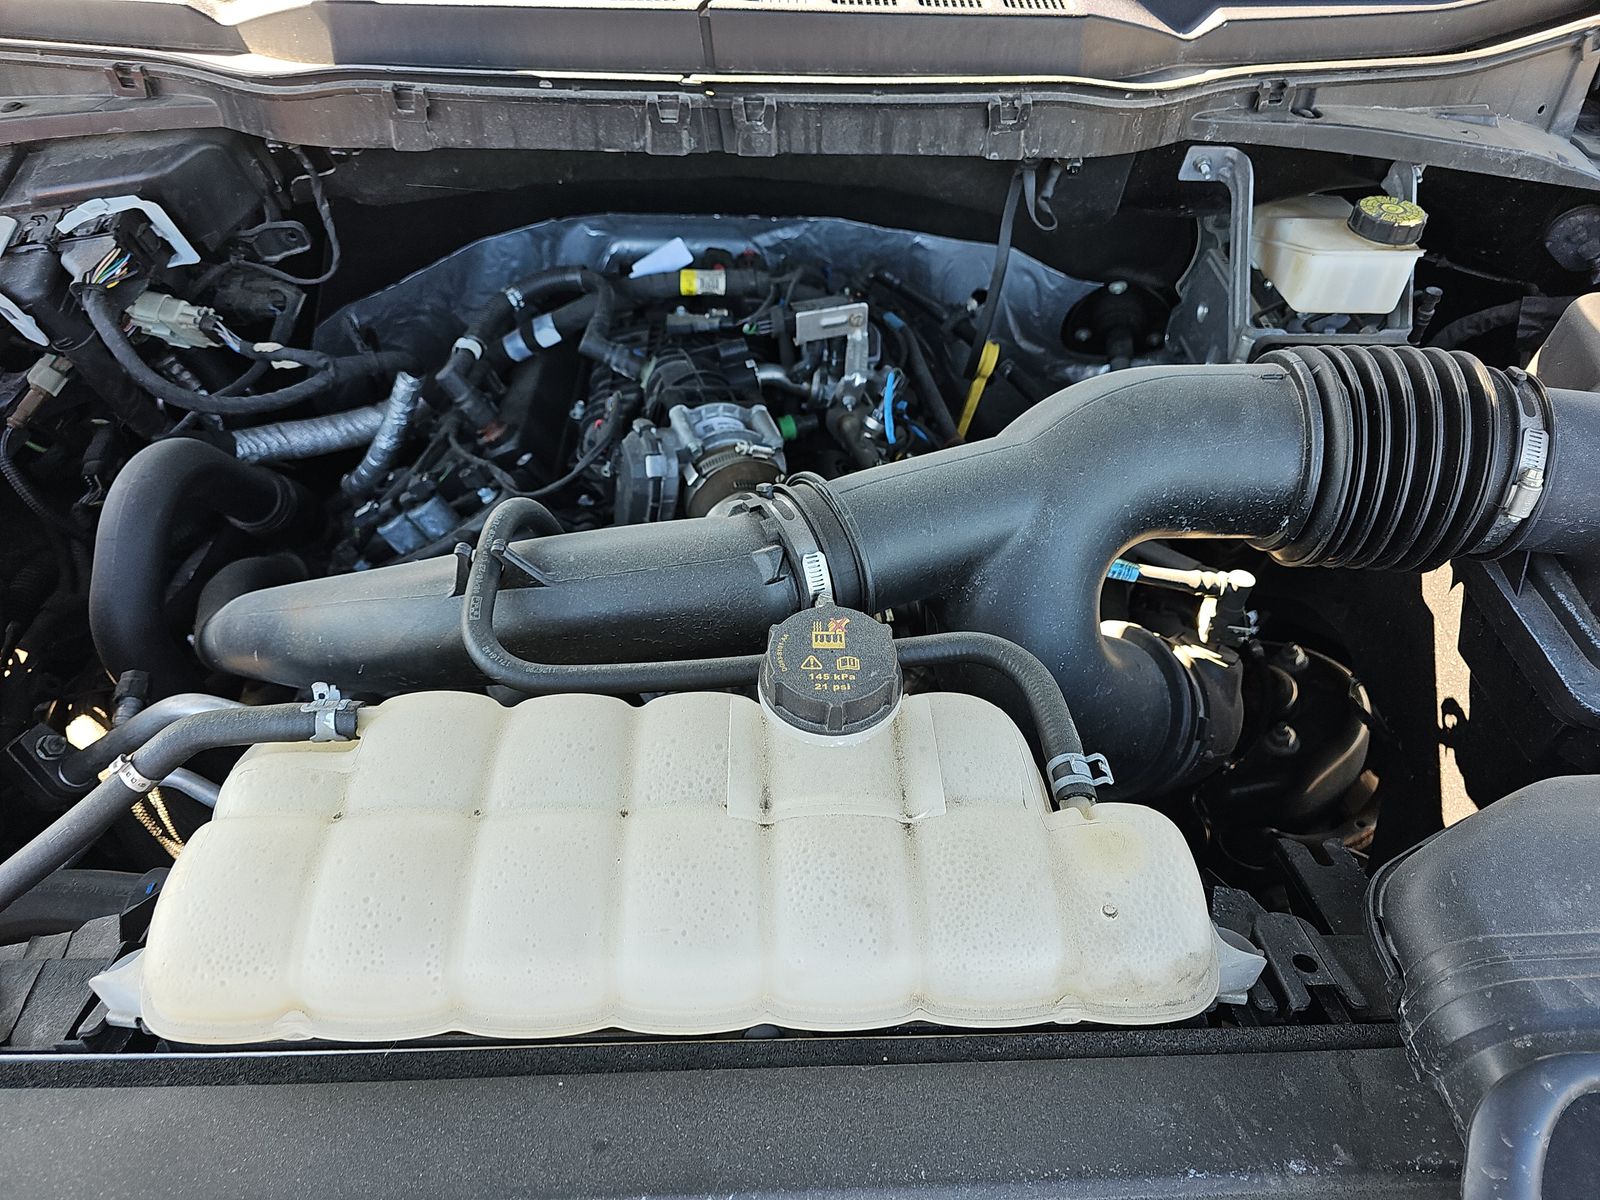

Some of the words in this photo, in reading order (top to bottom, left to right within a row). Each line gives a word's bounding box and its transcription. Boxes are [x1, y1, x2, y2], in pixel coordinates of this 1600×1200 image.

[808, 673, 830, 681] 145
[833, 673, 856, 681] kPa
[814, 683, 828, 691] 21
[832, 683, 851, 692] psi
